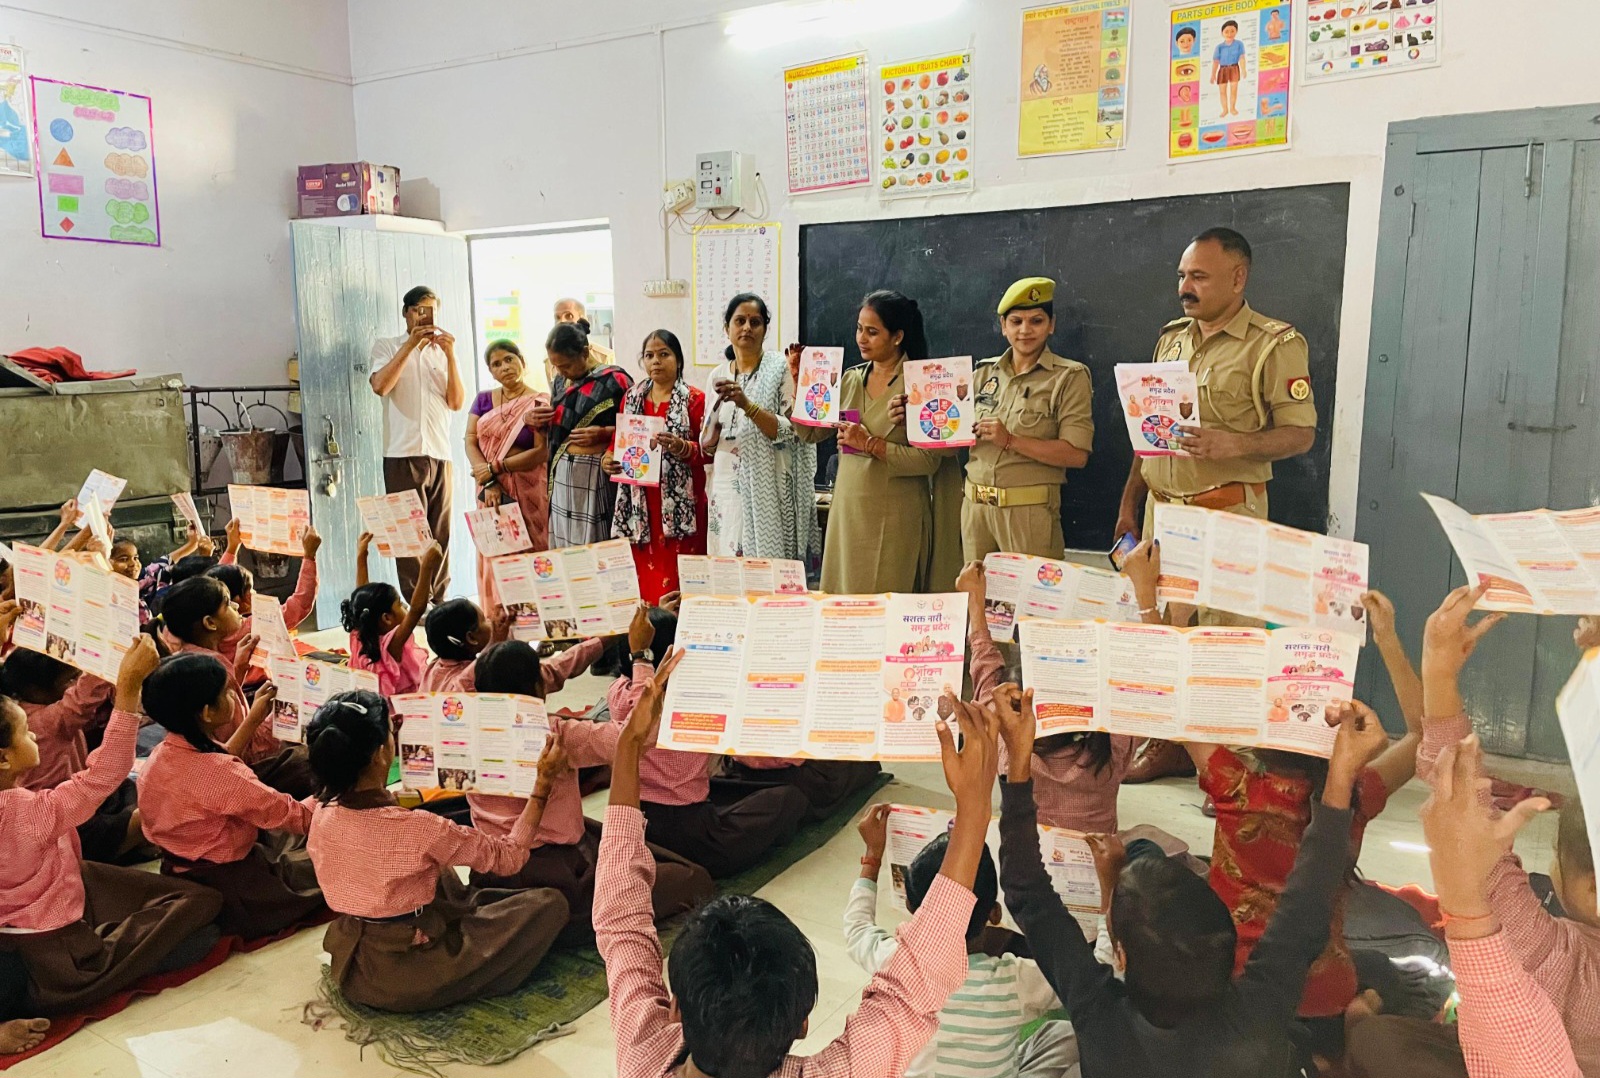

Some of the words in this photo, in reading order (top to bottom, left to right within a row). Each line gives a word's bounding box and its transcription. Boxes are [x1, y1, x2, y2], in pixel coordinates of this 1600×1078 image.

[1176, 10, 1203, 20] PARTS
[1205, 7, 1215, 15] OF
[1219, 4, 1233, 13] THE
[1236, 0, 1259, 10] BODY
[884, 66, 915, 76] PICTORIAL
[917, 61, 938, 72] FRUITS
[940, 57, 960, 67] CHART
[788, 68, 823, 79] NUMERICAL
[927, 613, 942, 622] नारी
[911, 624, 930, 635] समृद्ध
[932, 622, 950, 631] प्रदेश
